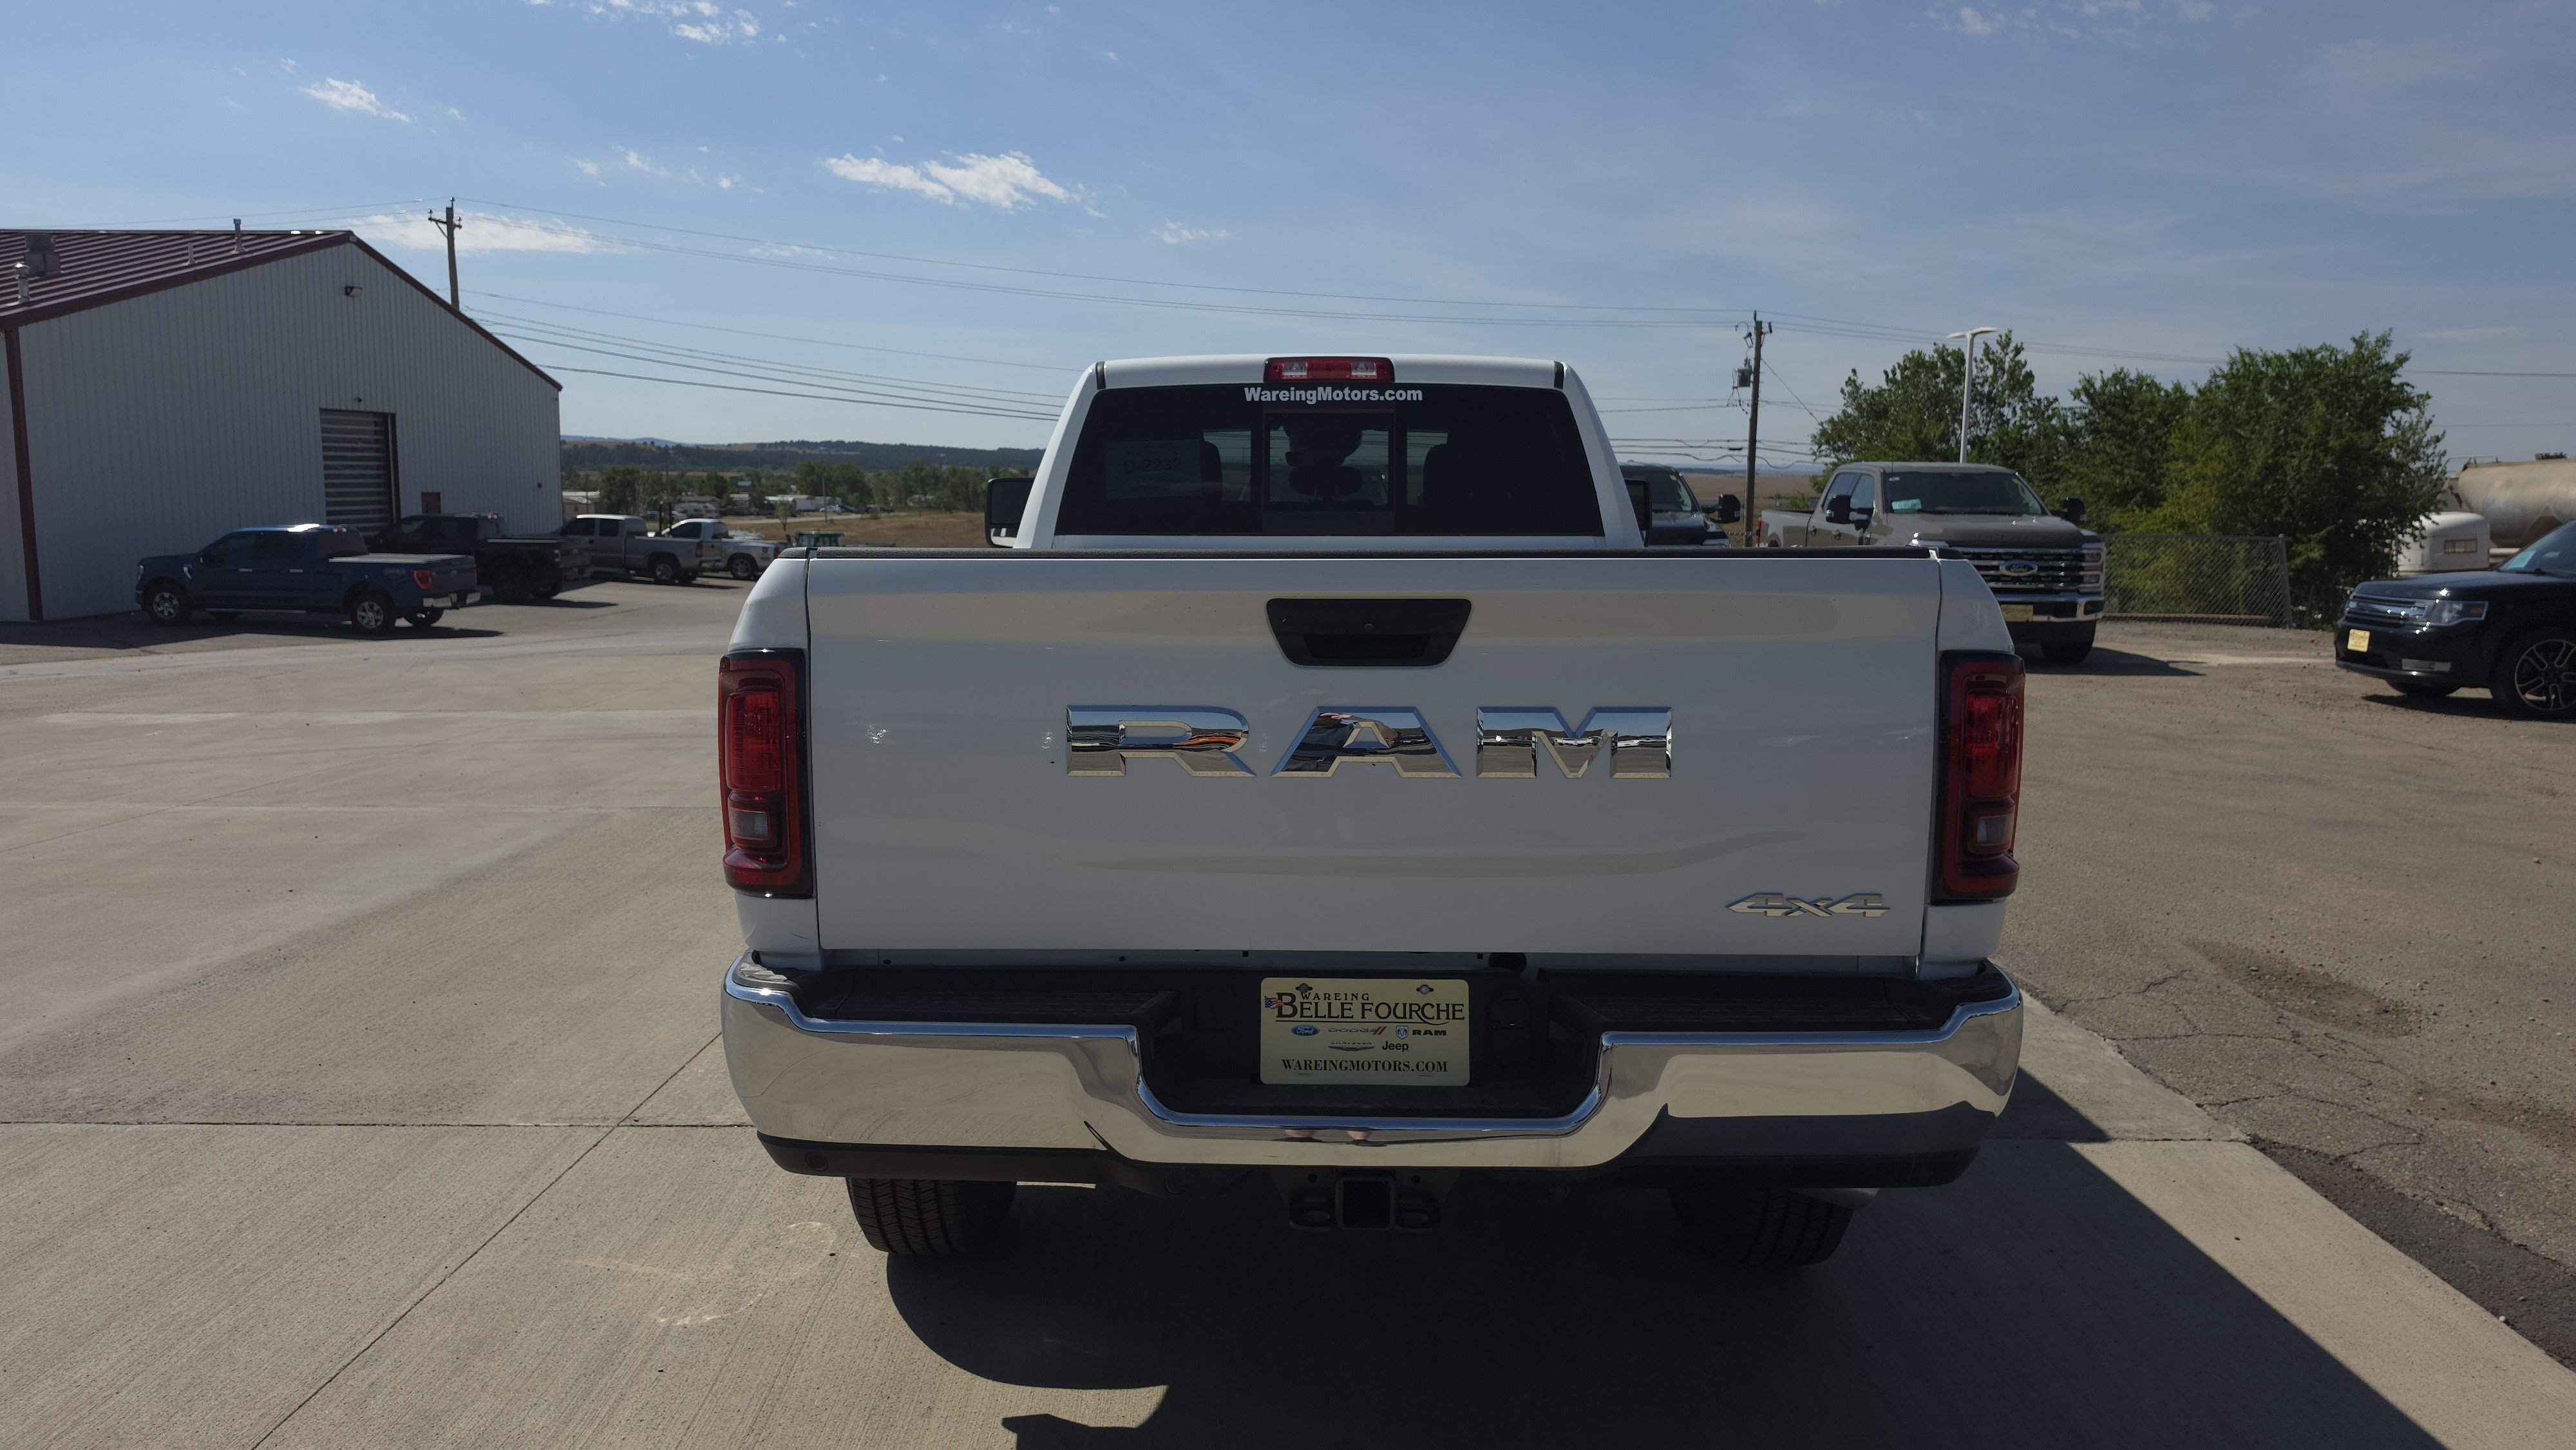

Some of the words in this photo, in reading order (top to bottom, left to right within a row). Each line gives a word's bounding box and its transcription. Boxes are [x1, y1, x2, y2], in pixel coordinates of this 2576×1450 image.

[1244, 387, 1423, 404] WareingMotors.com
[1066, 706, 1672, 778] RAM
[1725, 892, 1891, 917] 4x4
[1301, 992, 1370, 1001] WAREING
[1276, 992, 1354, 1019] BELLE
[1360, 1002, 1465, 1022] FOURCHE
[1294, 1026, 1315, 1035] Ford
[1381, 1040, 1409, 1052] Jeep
[1282, 1059, 1448, 1073] WAREINGMOTORS.COM
